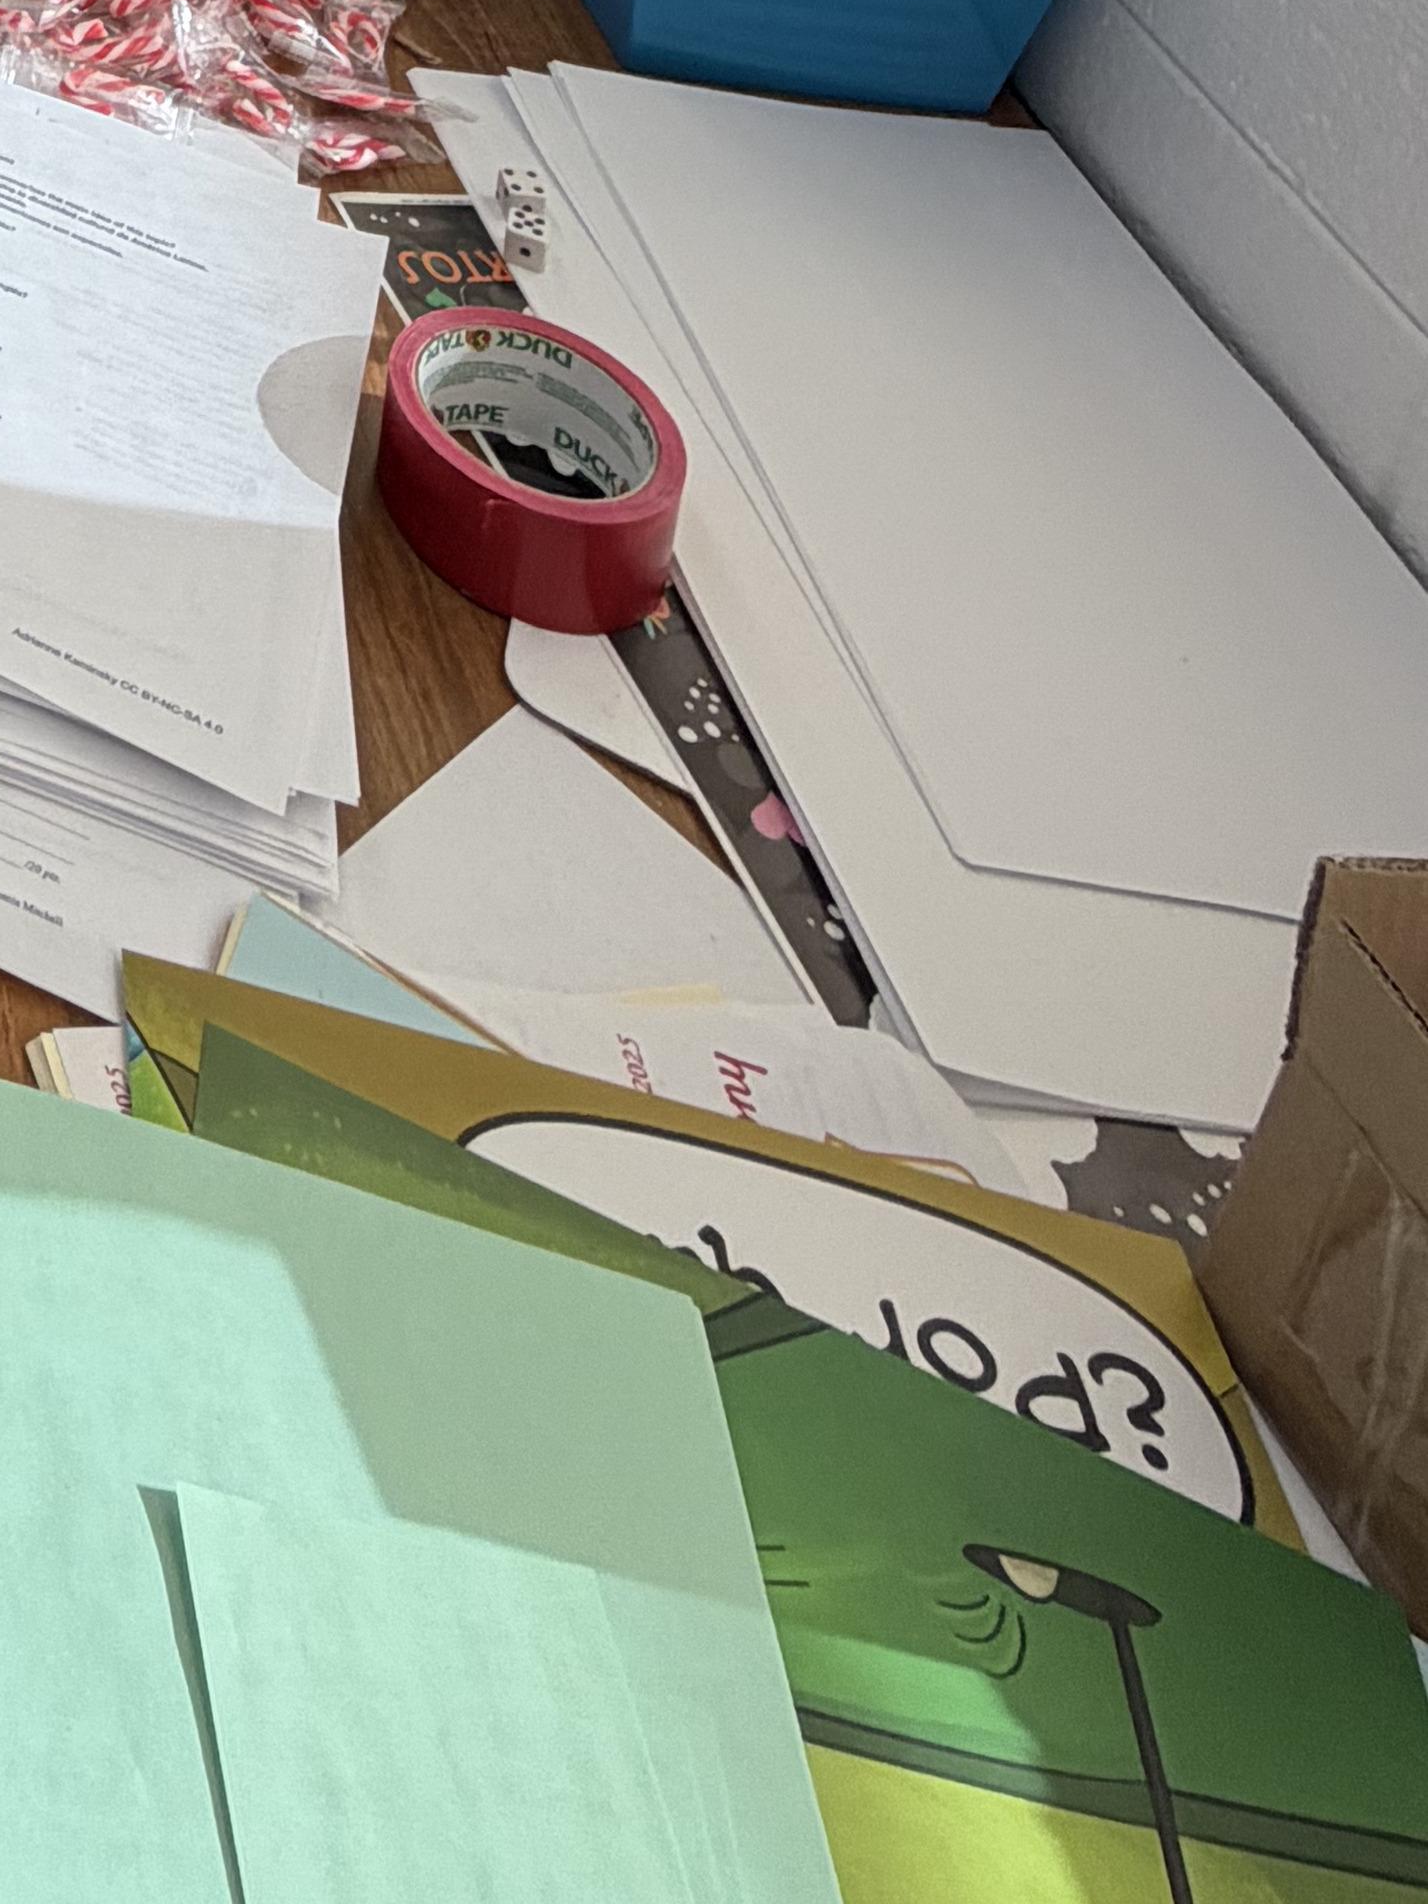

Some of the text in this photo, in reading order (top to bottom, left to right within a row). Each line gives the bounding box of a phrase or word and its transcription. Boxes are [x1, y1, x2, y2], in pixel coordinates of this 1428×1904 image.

[47, 192, 63, 203] the
[64, 199, 89, 214] main
[90, 209, 112, 223] idea
[113, 218, 124, 228] of
[125, 224, 144, 236] this
[498, 331, 573, 369] DUCK
[446, 403, 508, 424] TAPE
[554, 426, 620, 486] DUCK
[62, 651, 119, 686] Kaminsky
[118, 679, 139, 695] CC
[140, 689, 203, 725] BY-NC-SA
